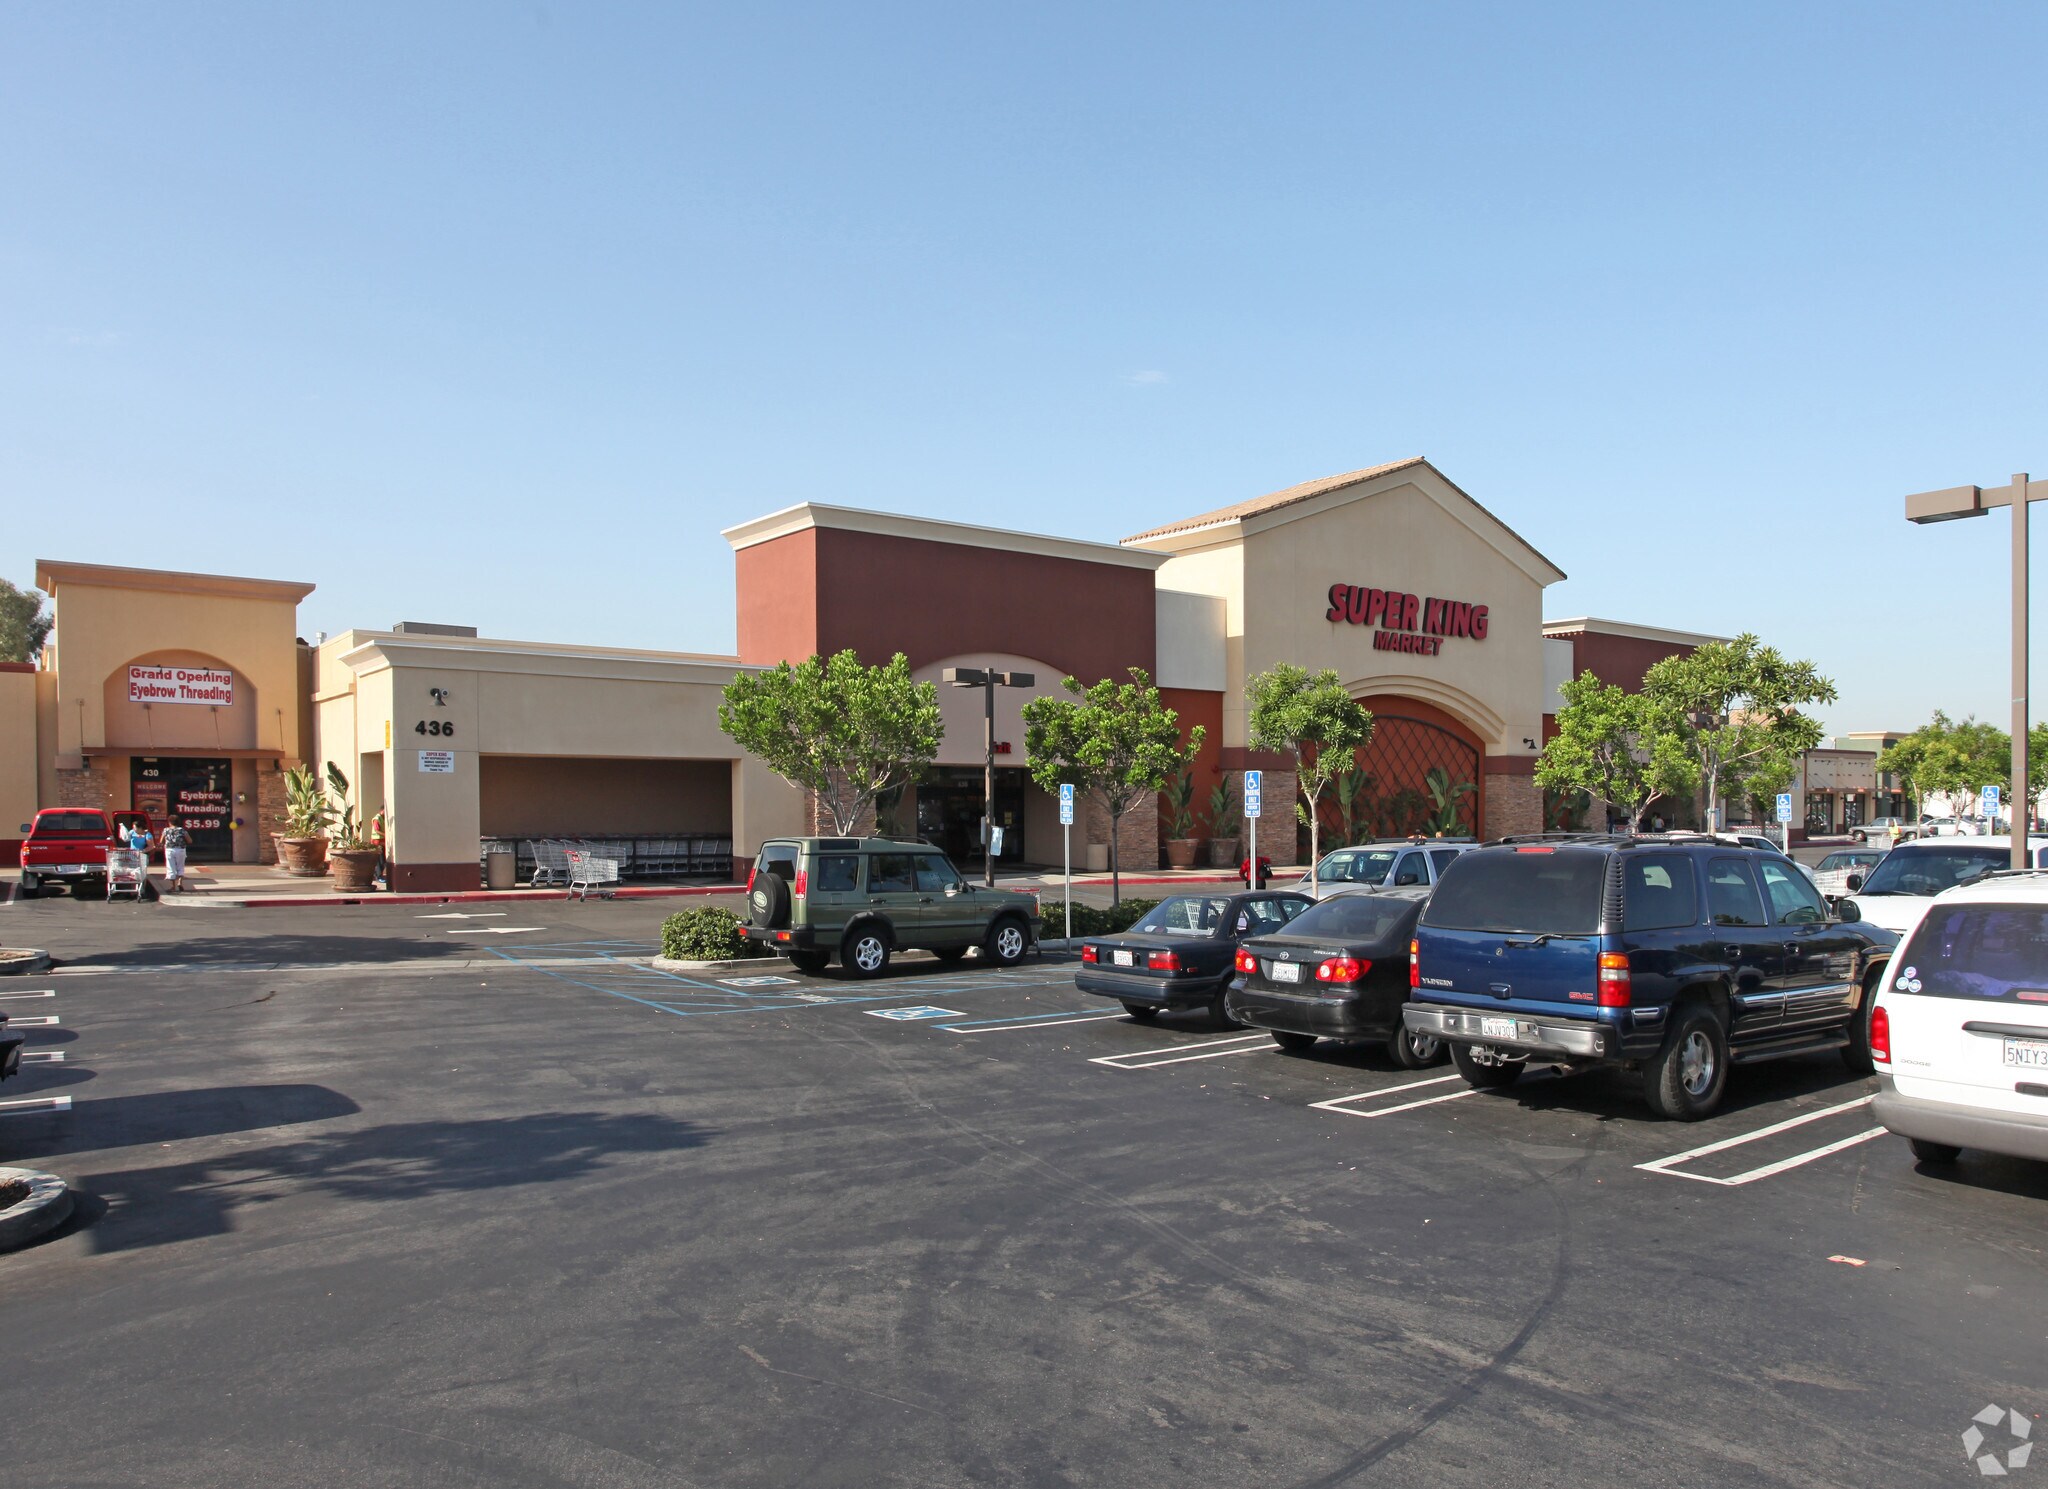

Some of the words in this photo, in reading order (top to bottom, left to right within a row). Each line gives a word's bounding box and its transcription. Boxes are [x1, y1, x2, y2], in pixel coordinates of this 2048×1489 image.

[1326, 583, 1420, 631] SUPER
[1422, 597, 1489, 640] KING
[1373, 630, 1444, 656] MARKET
[130, 668, 172, 680] Grand
[176, 671, 231, 685] Opening
[130, 682, 176, 700] Eyebrow
[179, 685, 232, 704] Threading
[415, 720, 454, 737] 436
[142, 769, 159, 777] 430
[180, 791, 223, 801] Eyebrow
[176, 804, 227, 814] Threading
[184, 819, 221, 829] $5.99
[1421, 977, 1453, 987] YUKON
[1569, 992, 1594, 1000] GMC
[1900, 1058, 1931, 1067] DODGE
